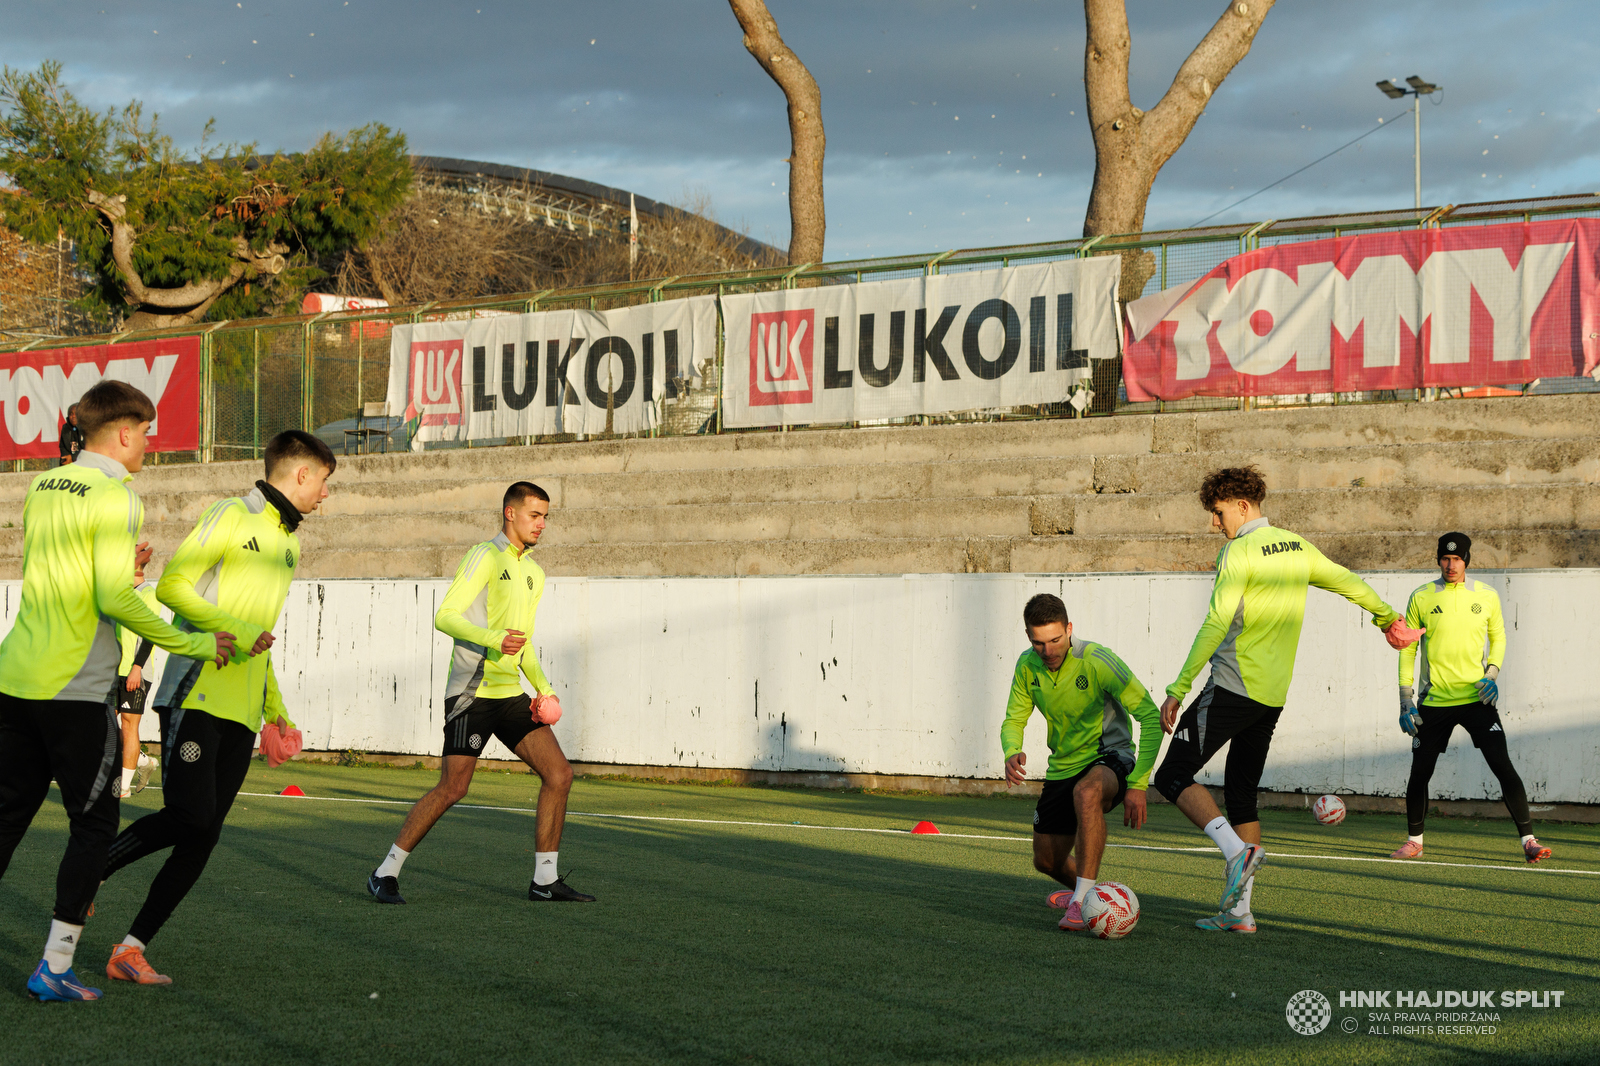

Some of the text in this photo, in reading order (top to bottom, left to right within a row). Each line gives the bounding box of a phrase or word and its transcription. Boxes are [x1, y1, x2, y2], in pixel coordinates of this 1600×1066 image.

[823, 292, 1089, 390] LUKOIL
[1162, 242, 1575, 380] TOMMY
[472, 328, 690, 412] LUKOIL
[36, 478, 92, 498] HAJDUK
[1261, 541, 1303, 556] HAJDUK
